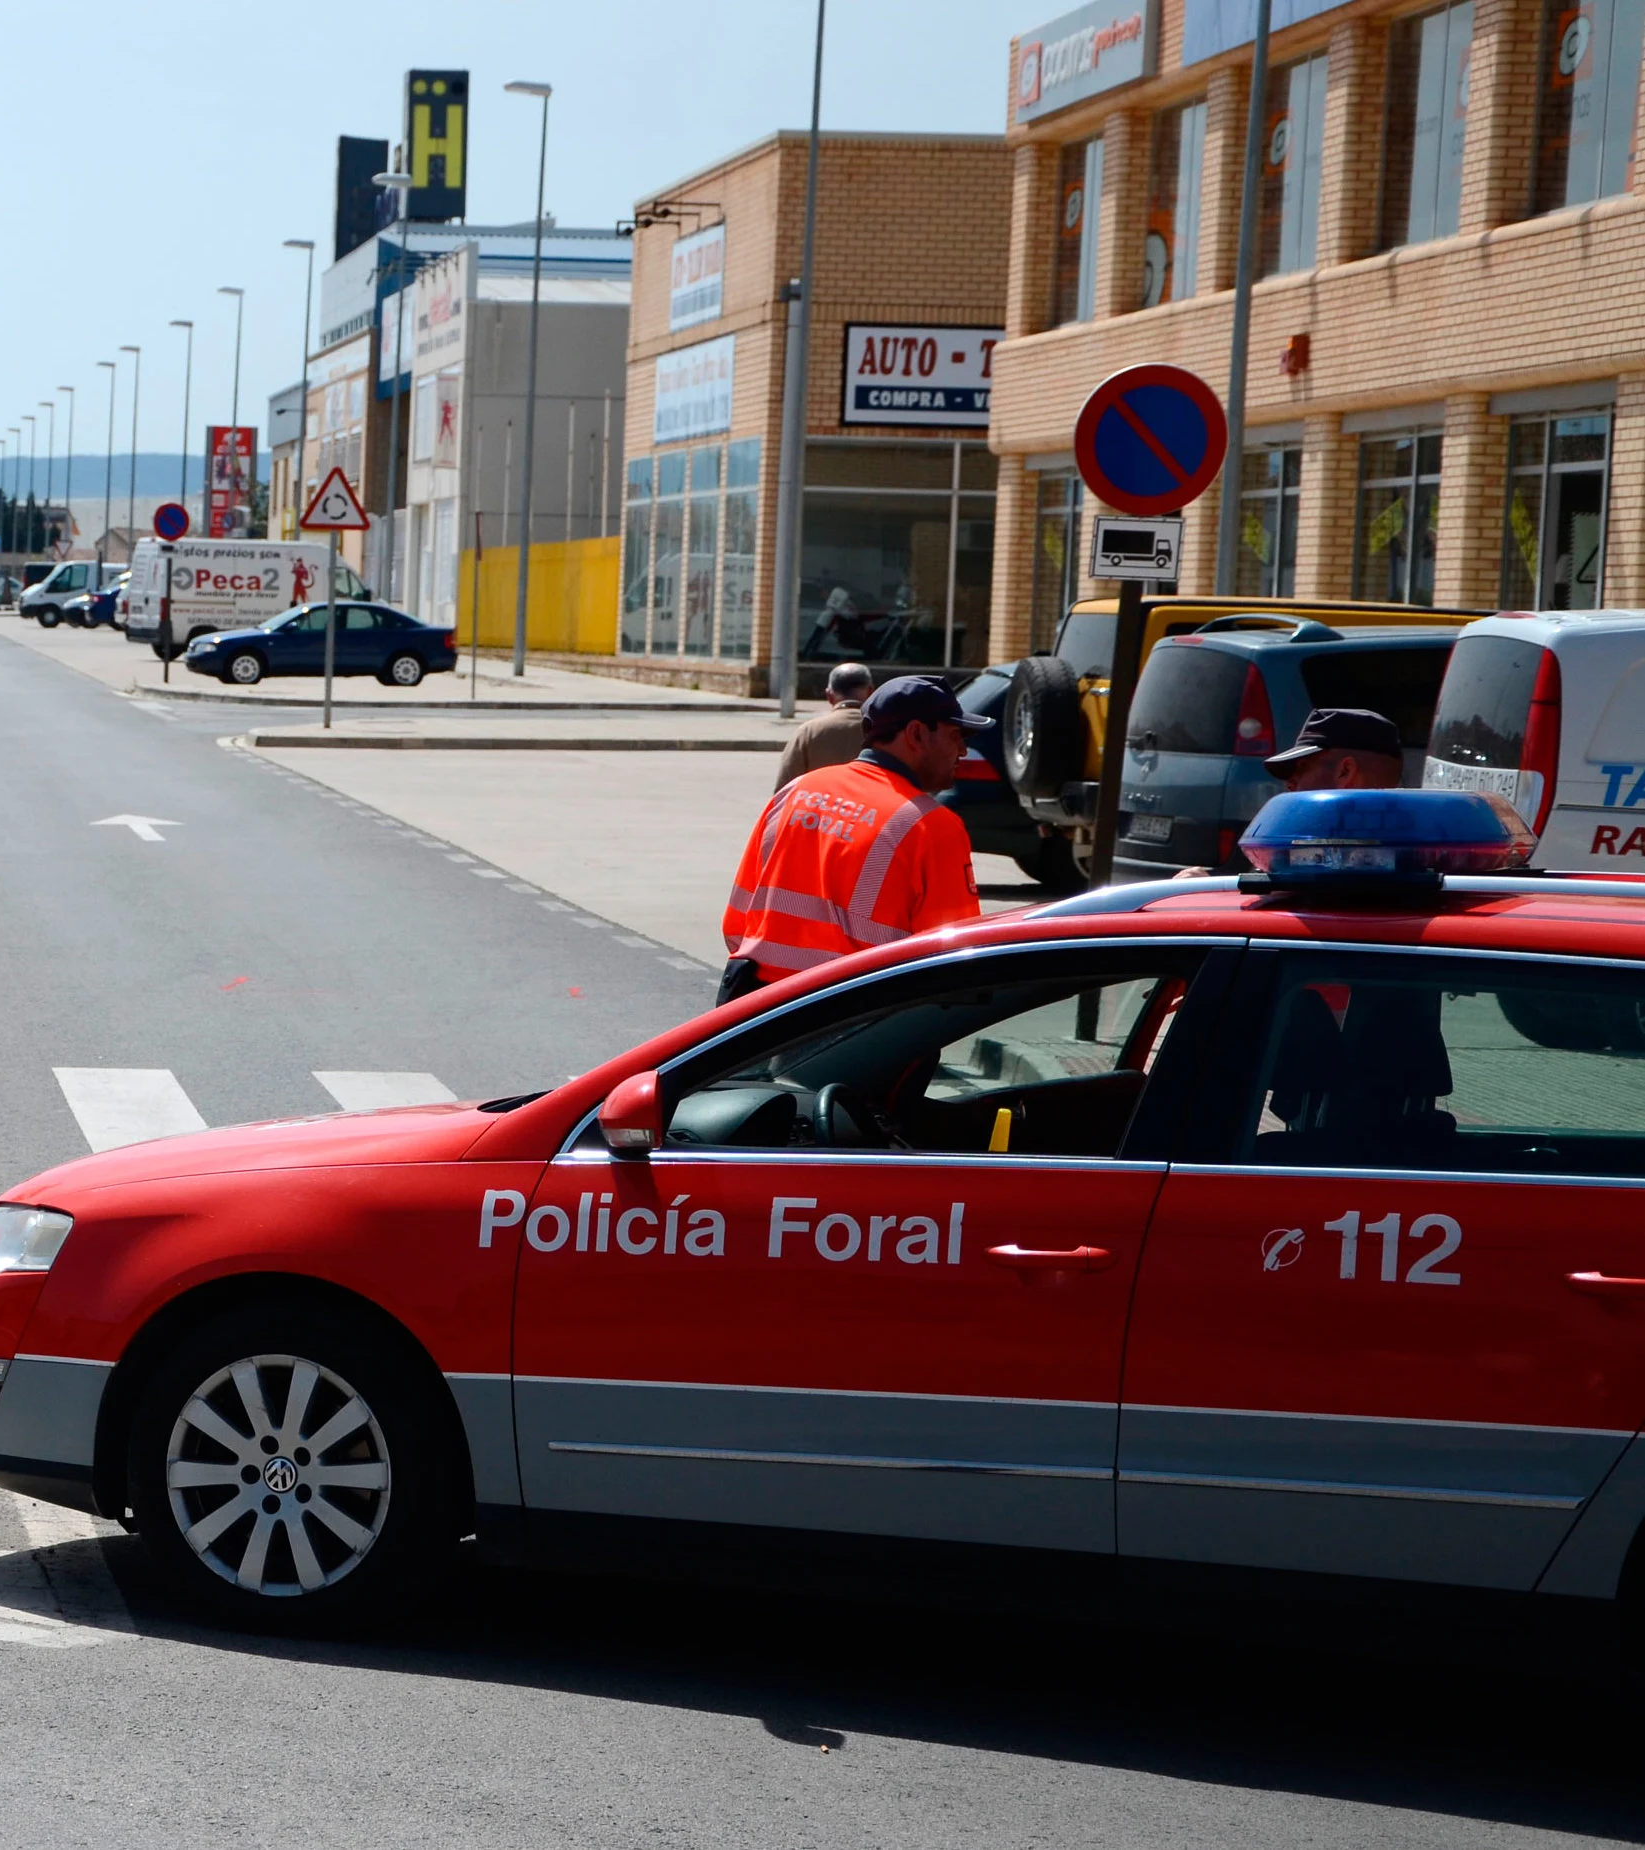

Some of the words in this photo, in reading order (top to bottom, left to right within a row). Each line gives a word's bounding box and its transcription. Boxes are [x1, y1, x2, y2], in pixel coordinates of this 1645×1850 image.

[858, 336, 938, 377] AUTO
[868, 390, 946, 408] COMPRA
[213, 547, 256, 559] precios
[195, 568, 280, 591] Peca2
[789, 809, 854, 843] FORAL
[792, 789, 877, 828] POLICIA
[478, 1189, 726, 1257] Policía
[767, 1196, 965, 1264] Foral
[1324, 1210, 1462, 1285] 112
